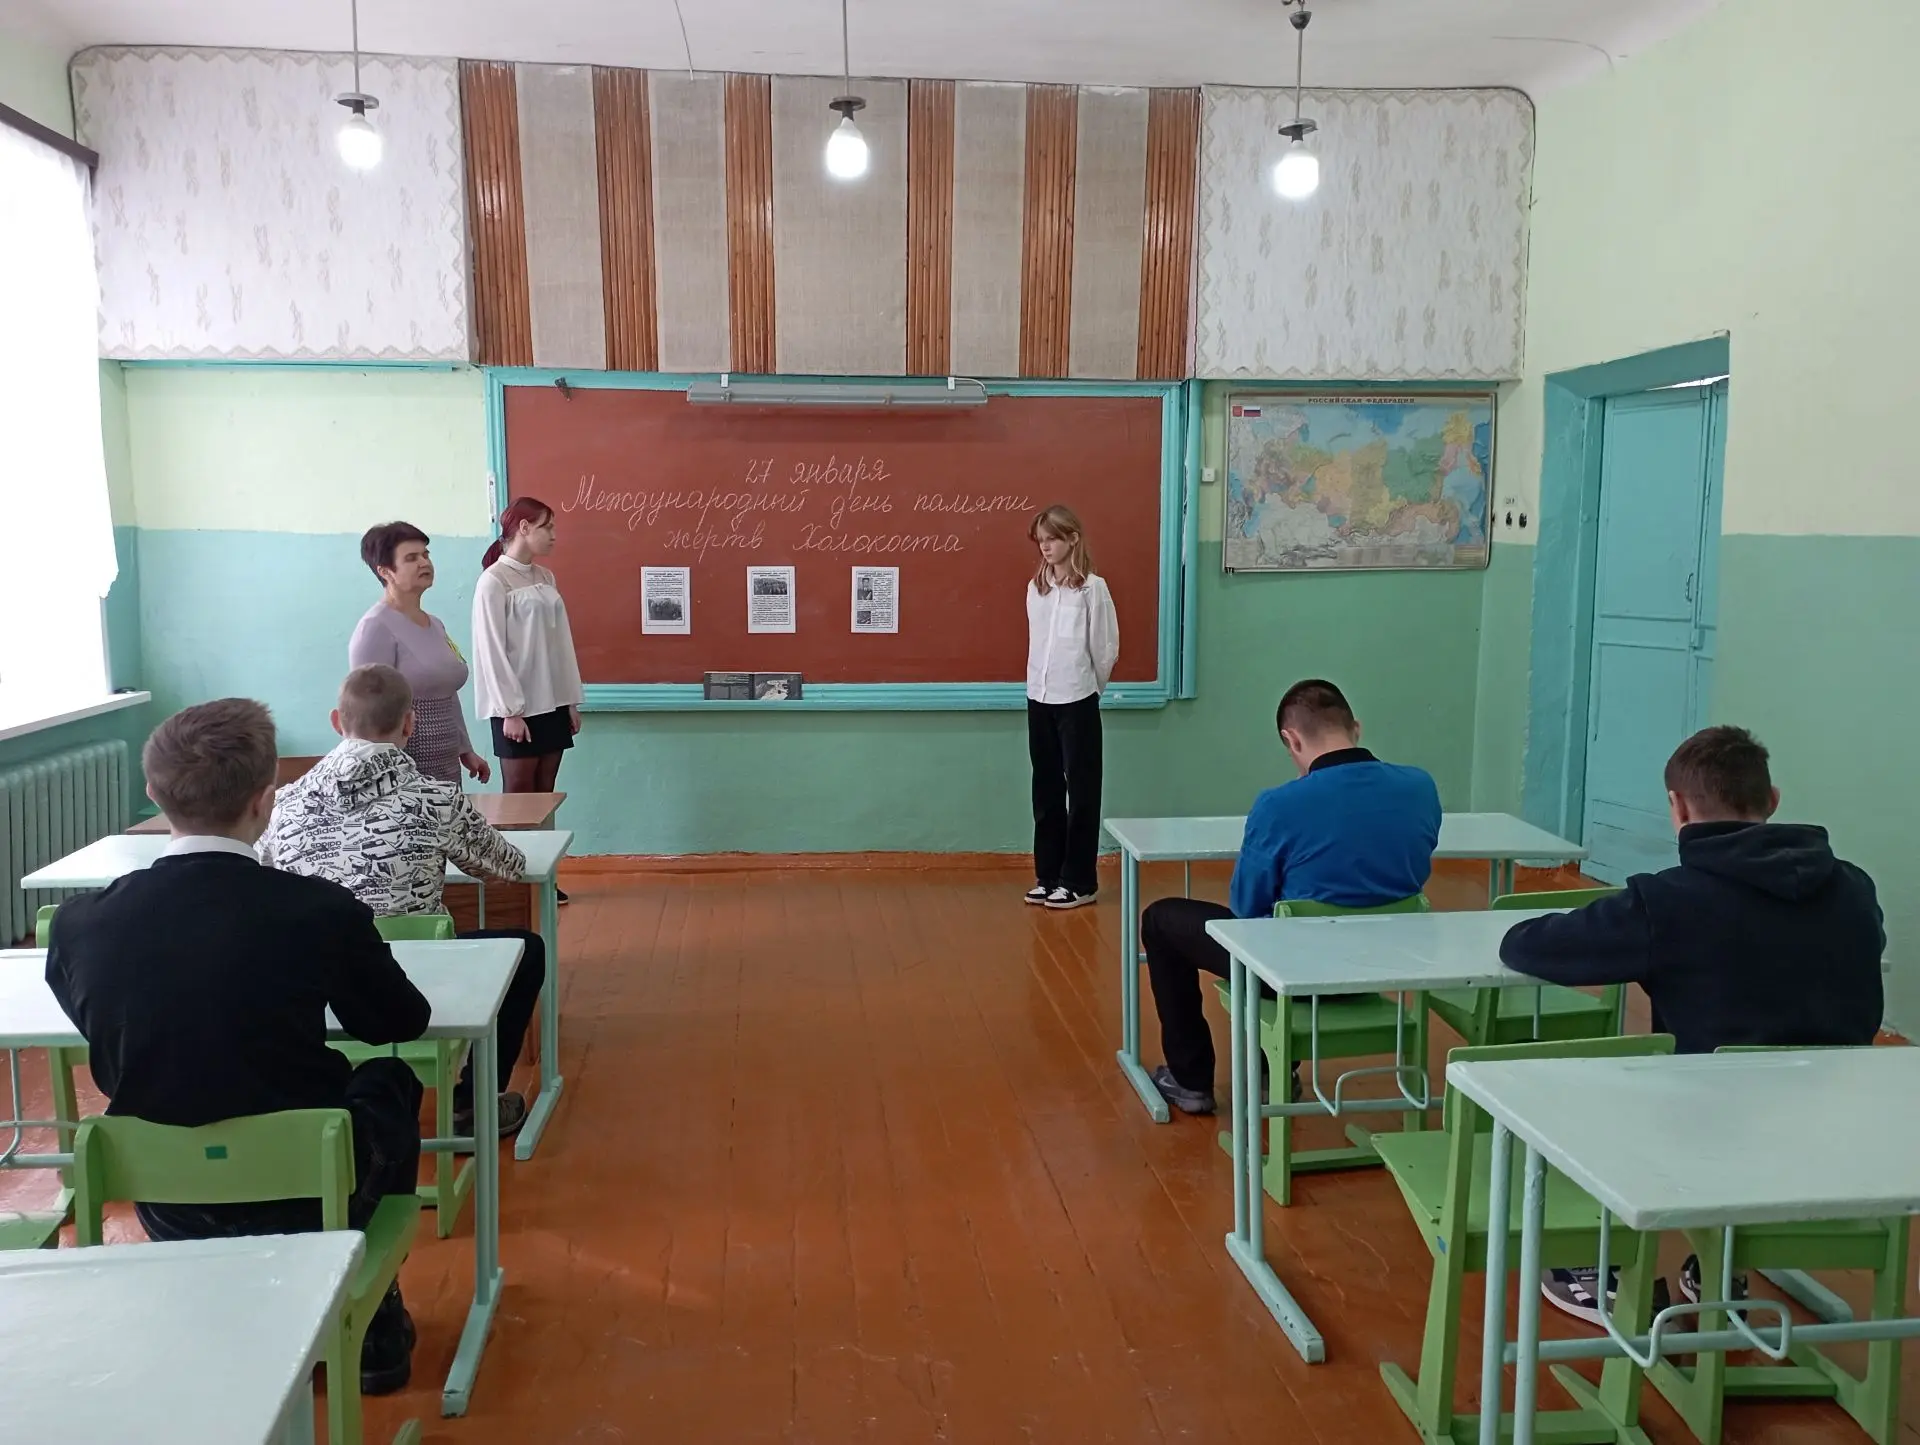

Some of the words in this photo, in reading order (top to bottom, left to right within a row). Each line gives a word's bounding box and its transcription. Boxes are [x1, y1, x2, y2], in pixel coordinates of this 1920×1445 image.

[745, 458, 774, 484] 27
[790, 455, 891, 499] января
[561, 473, 810, 533] Международный
[830, 494, 894, 529] день
[913, 491, 1037, 513] памяти
[663, 520, 766, 564] жертв
[792, 523, 964, 552] Холокоста
[306, 826, 342, 837] adidas
[403, 829, 437, 837] adidas
[305, 851, 340, 862] adidas
[400, 853, 432, 862] adidas
[354, 888, 390, 896] adidas
